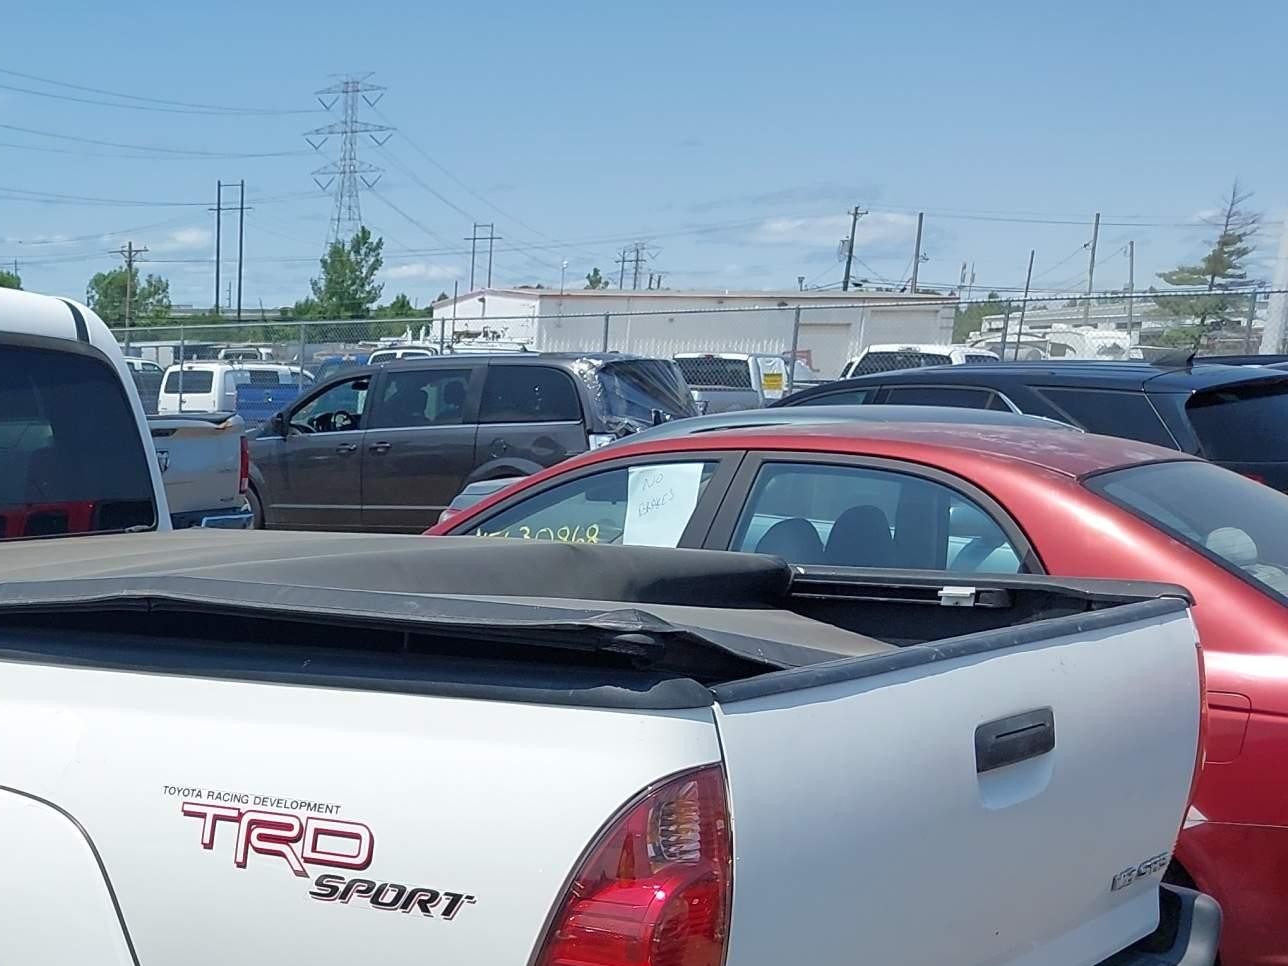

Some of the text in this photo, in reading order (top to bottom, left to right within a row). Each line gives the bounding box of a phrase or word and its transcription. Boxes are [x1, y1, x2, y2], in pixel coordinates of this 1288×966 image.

[163, 785, 342, 816] TOYOTA RACING DEVELOPMENT
[181, 801, 375, 879] TRD
[308, 873, 478, 921] SPORT
